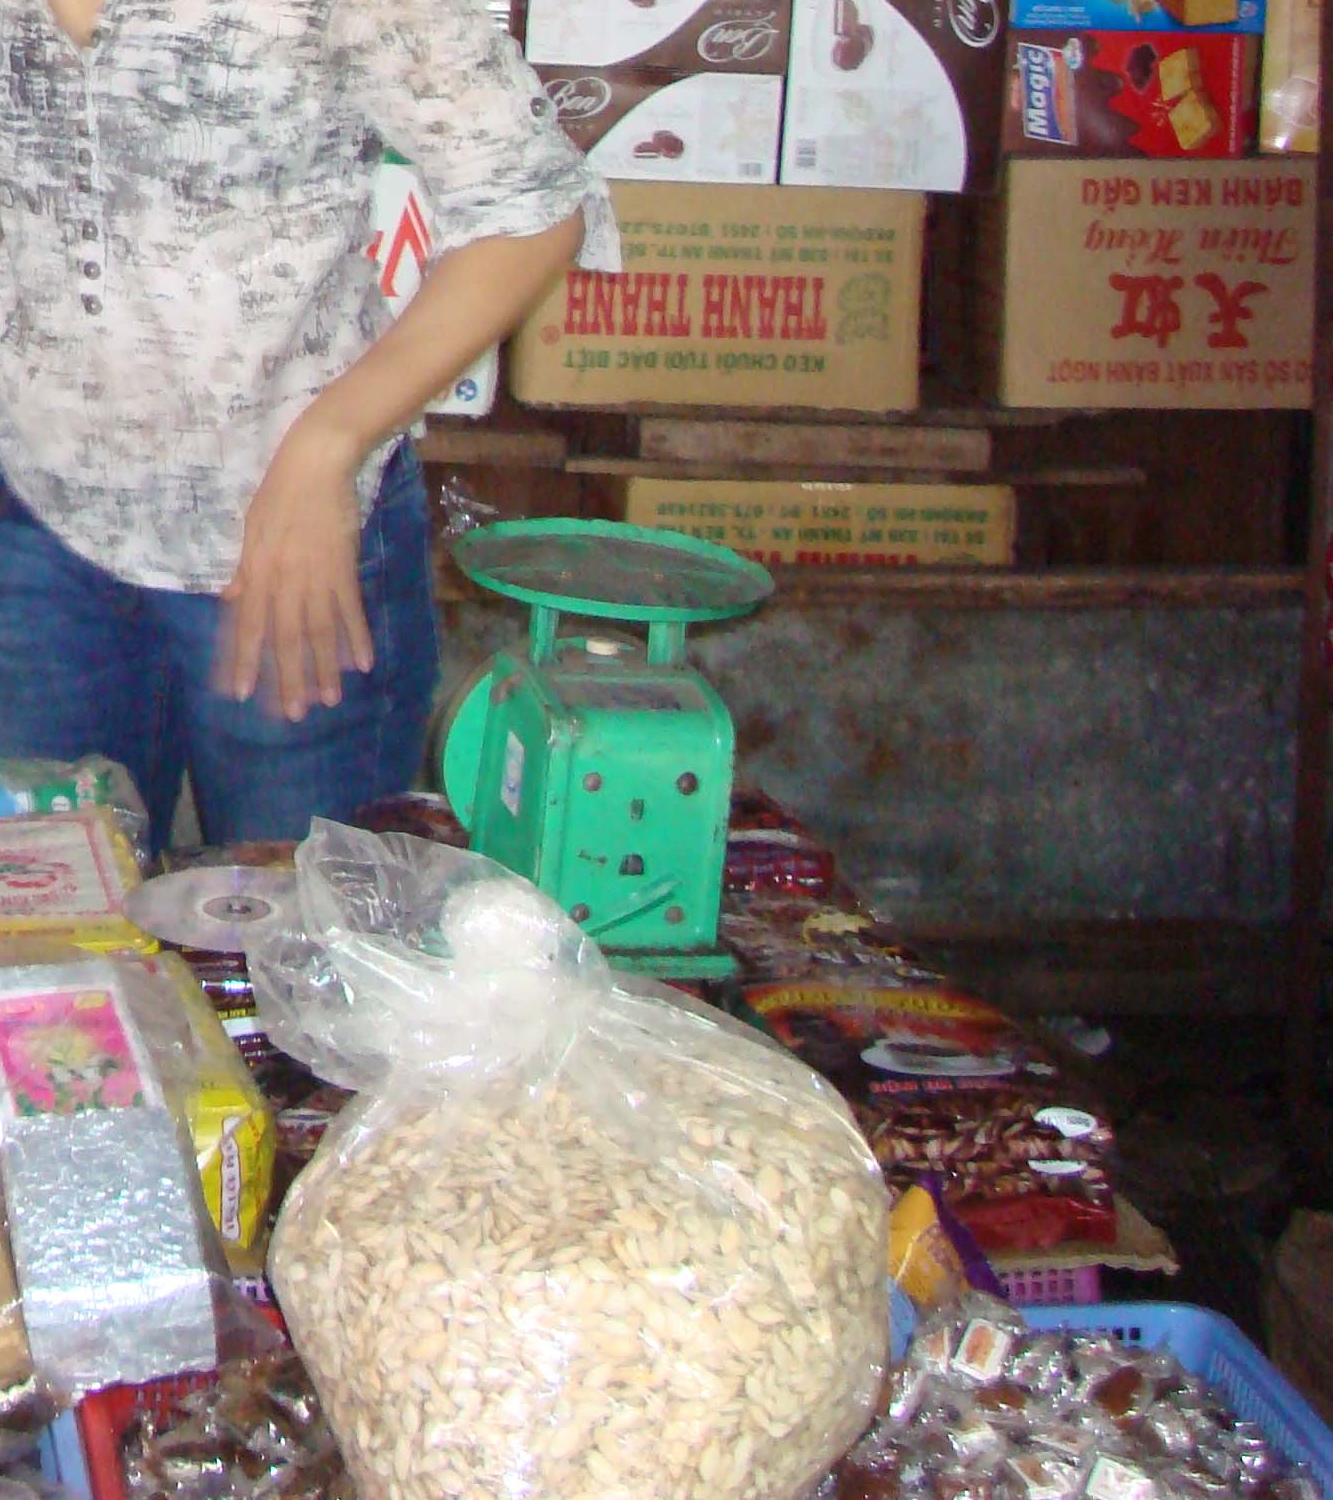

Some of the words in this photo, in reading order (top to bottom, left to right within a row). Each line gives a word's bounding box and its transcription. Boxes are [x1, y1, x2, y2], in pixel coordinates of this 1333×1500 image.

[1027, 49, 1051, 136] Magic
[1081, 177, 1141, 215] GẤU
[1150, 179, 1212, 206] KEM
[1221, 178, 1302, 209] BÁNH
[563, 271, 691, 338] THANH
[701, 276, 827, 341] THANH
[1109, 272, 1267, 348] 天虹
